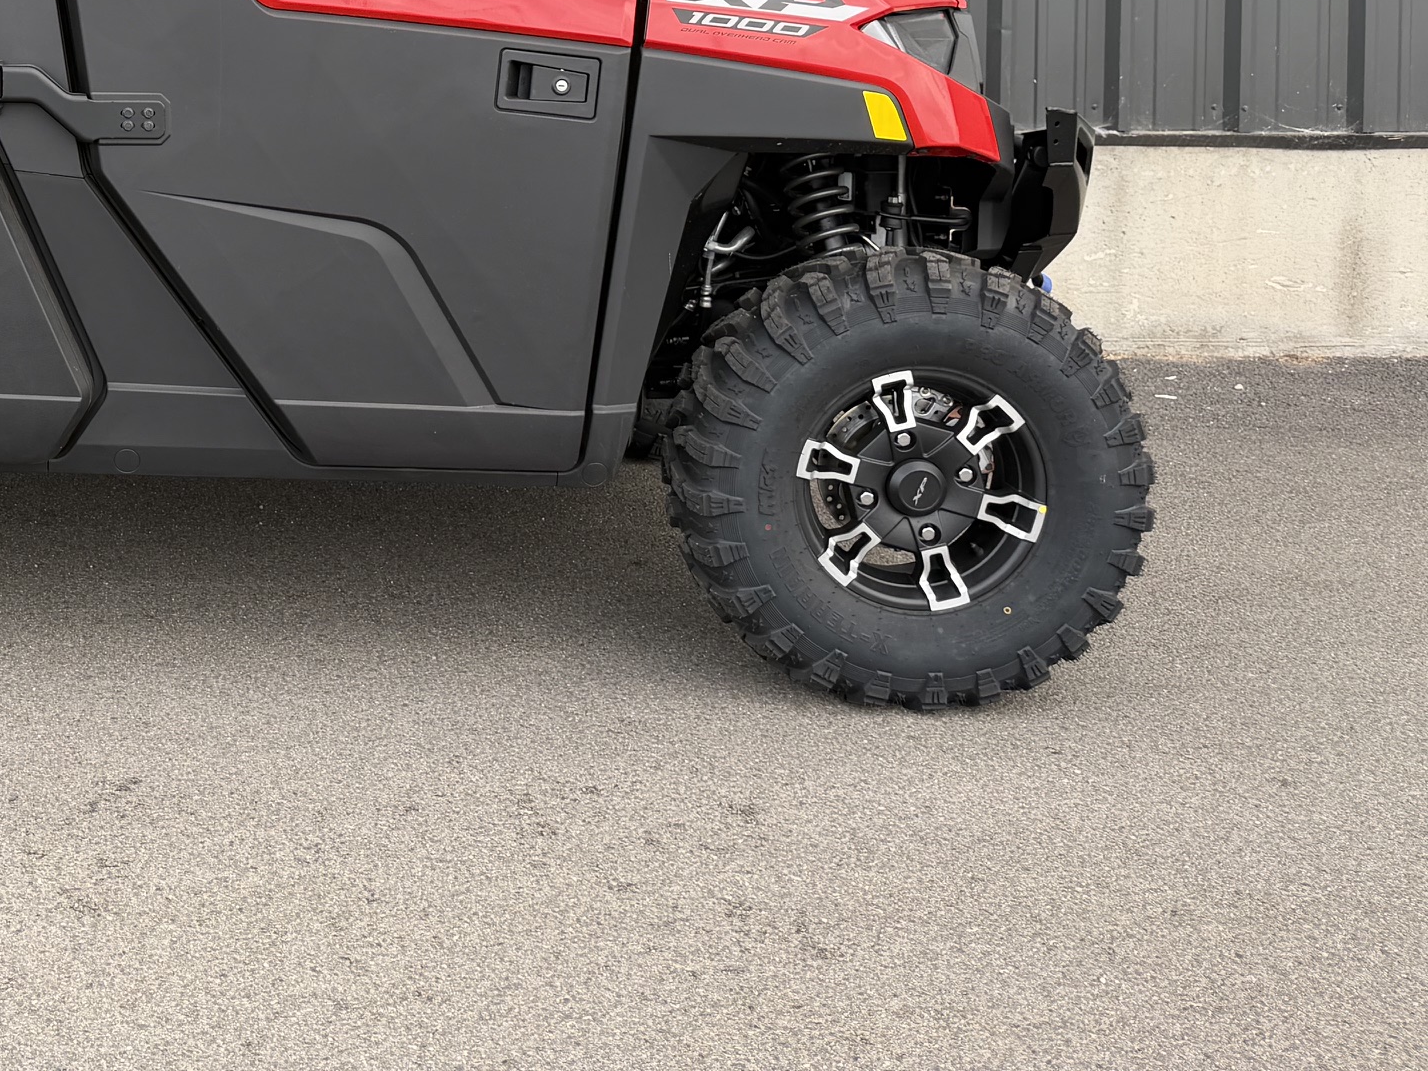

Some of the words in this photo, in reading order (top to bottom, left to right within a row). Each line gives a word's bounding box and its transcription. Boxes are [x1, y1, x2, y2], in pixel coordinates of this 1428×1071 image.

[688, 11, 810, 36] 1000
[912, 476, 928, 507] XP
[768, 546, 894, 656] X-TERRAIN
